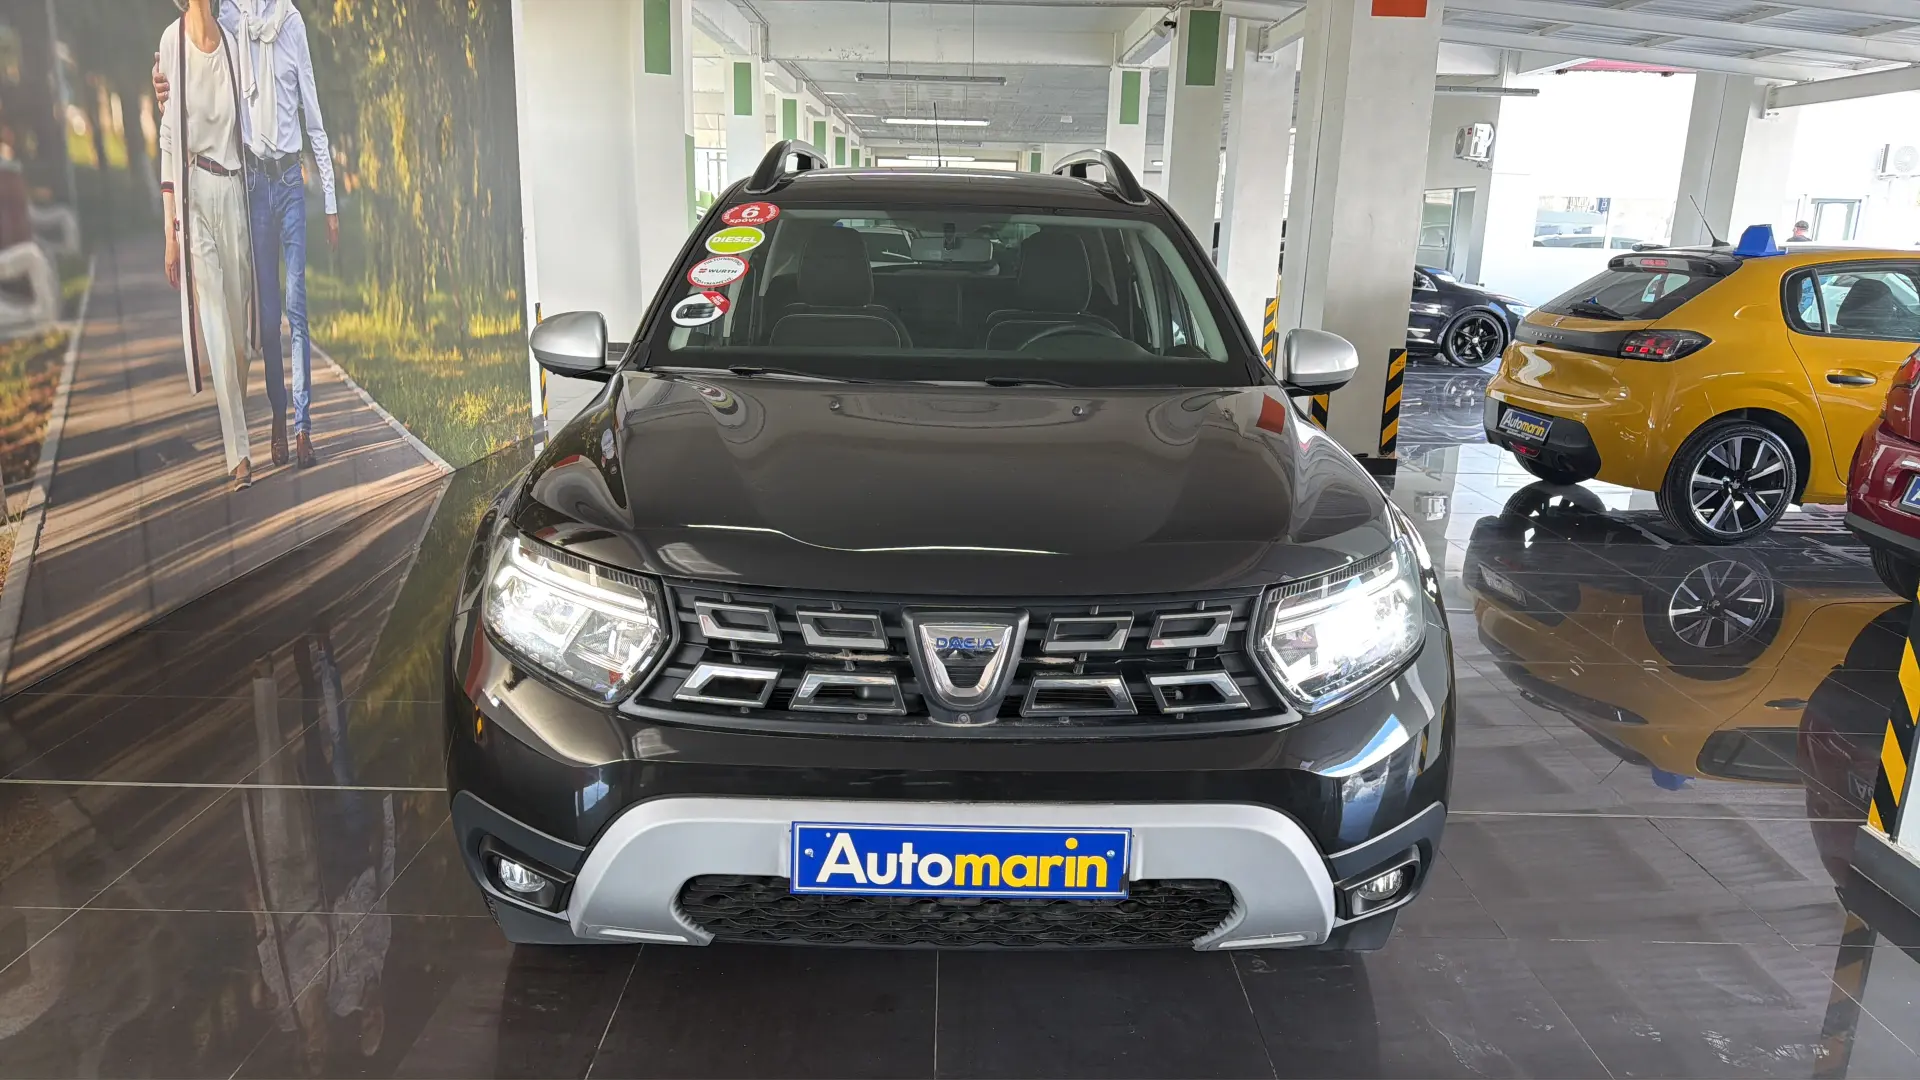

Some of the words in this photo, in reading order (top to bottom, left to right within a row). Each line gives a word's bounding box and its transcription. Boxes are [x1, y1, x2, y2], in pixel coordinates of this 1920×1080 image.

[741, 207, 760, 218] 6
[1502, 412, 1545, 437] Automarin
[935, 637, 996, 649] DACIA
[815, 832, 1108, 888] Automarin
